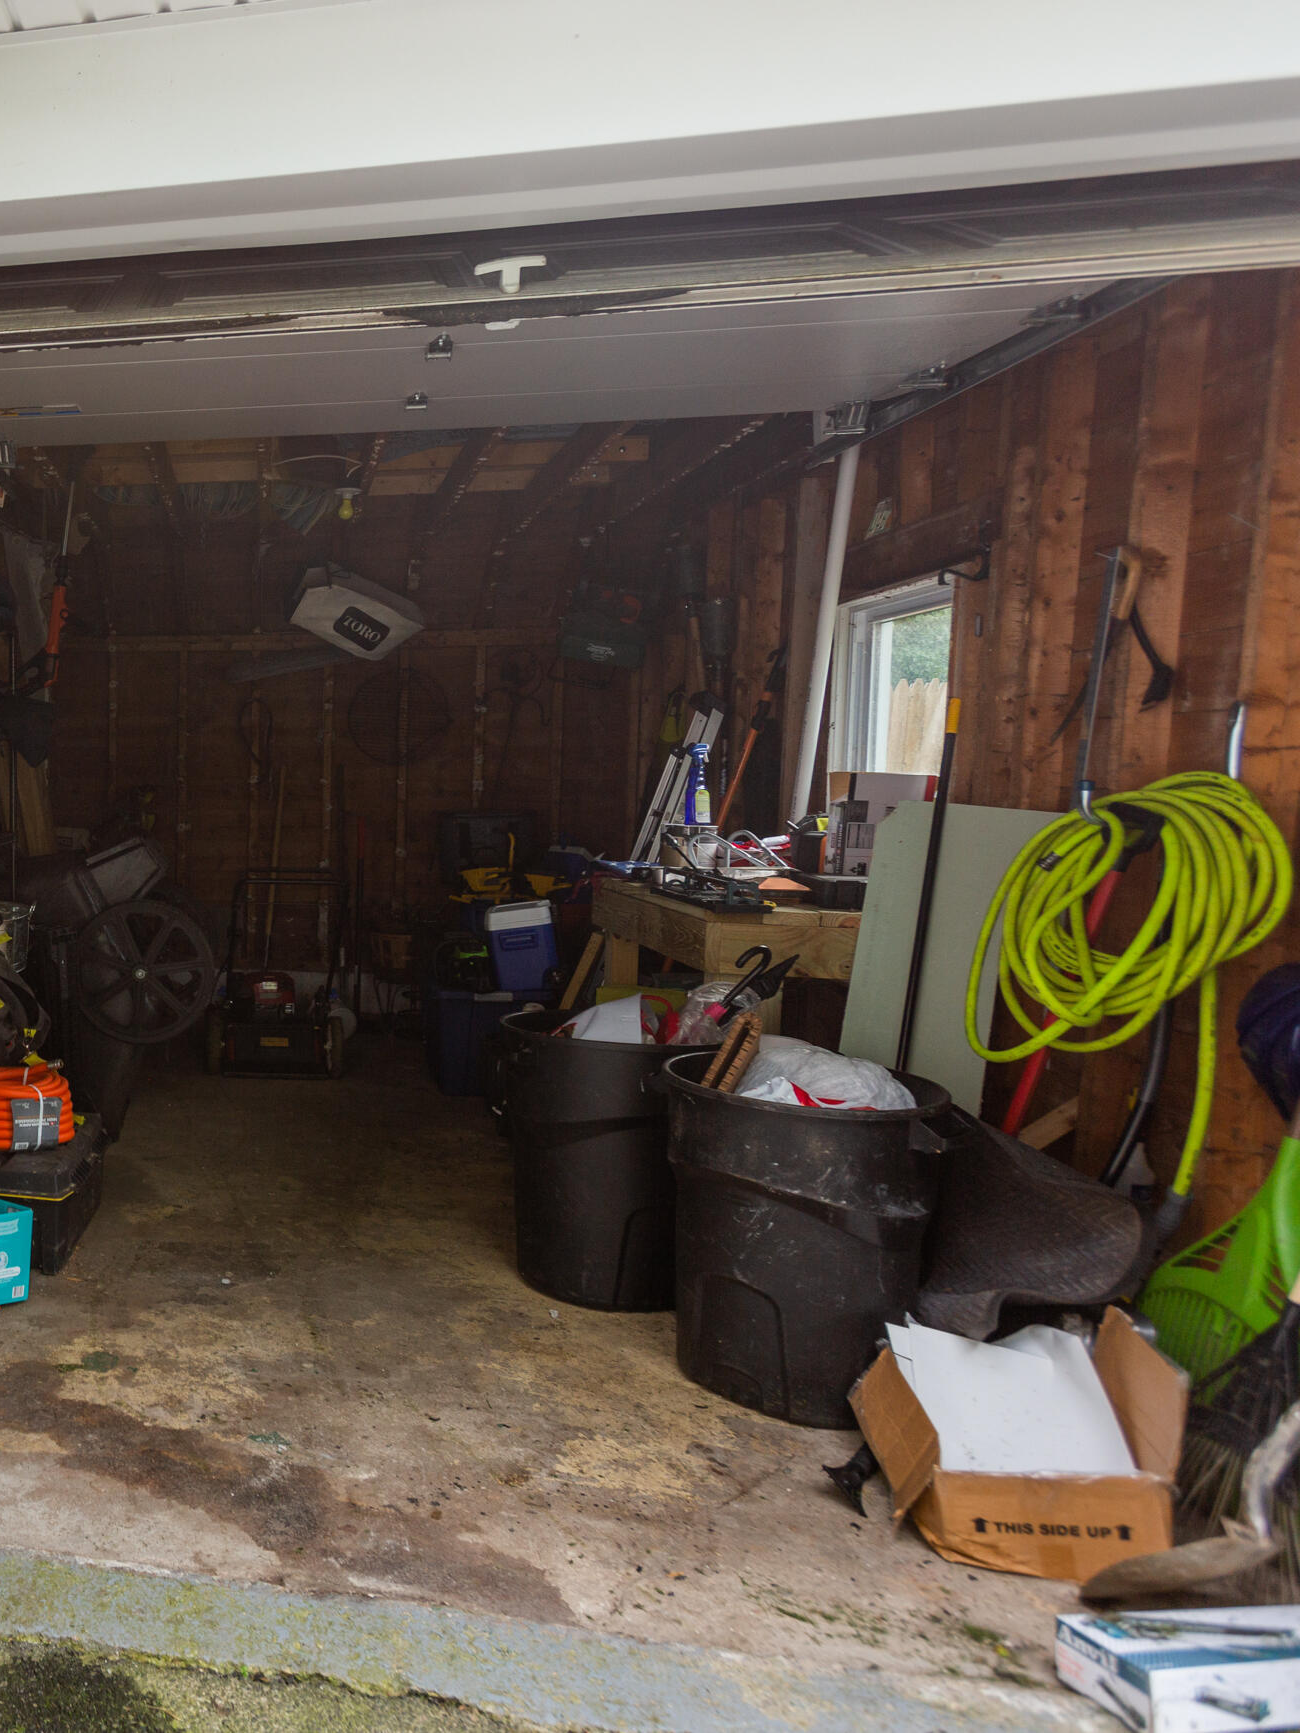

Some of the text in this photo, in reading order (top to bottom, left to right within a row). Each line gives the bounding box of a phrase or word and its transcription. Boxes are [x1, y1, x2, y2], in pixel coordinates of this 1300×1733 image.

[343, 615, 381, 642] TORO
[994, 1521, 1111, 1538] THIS SIDE UP
